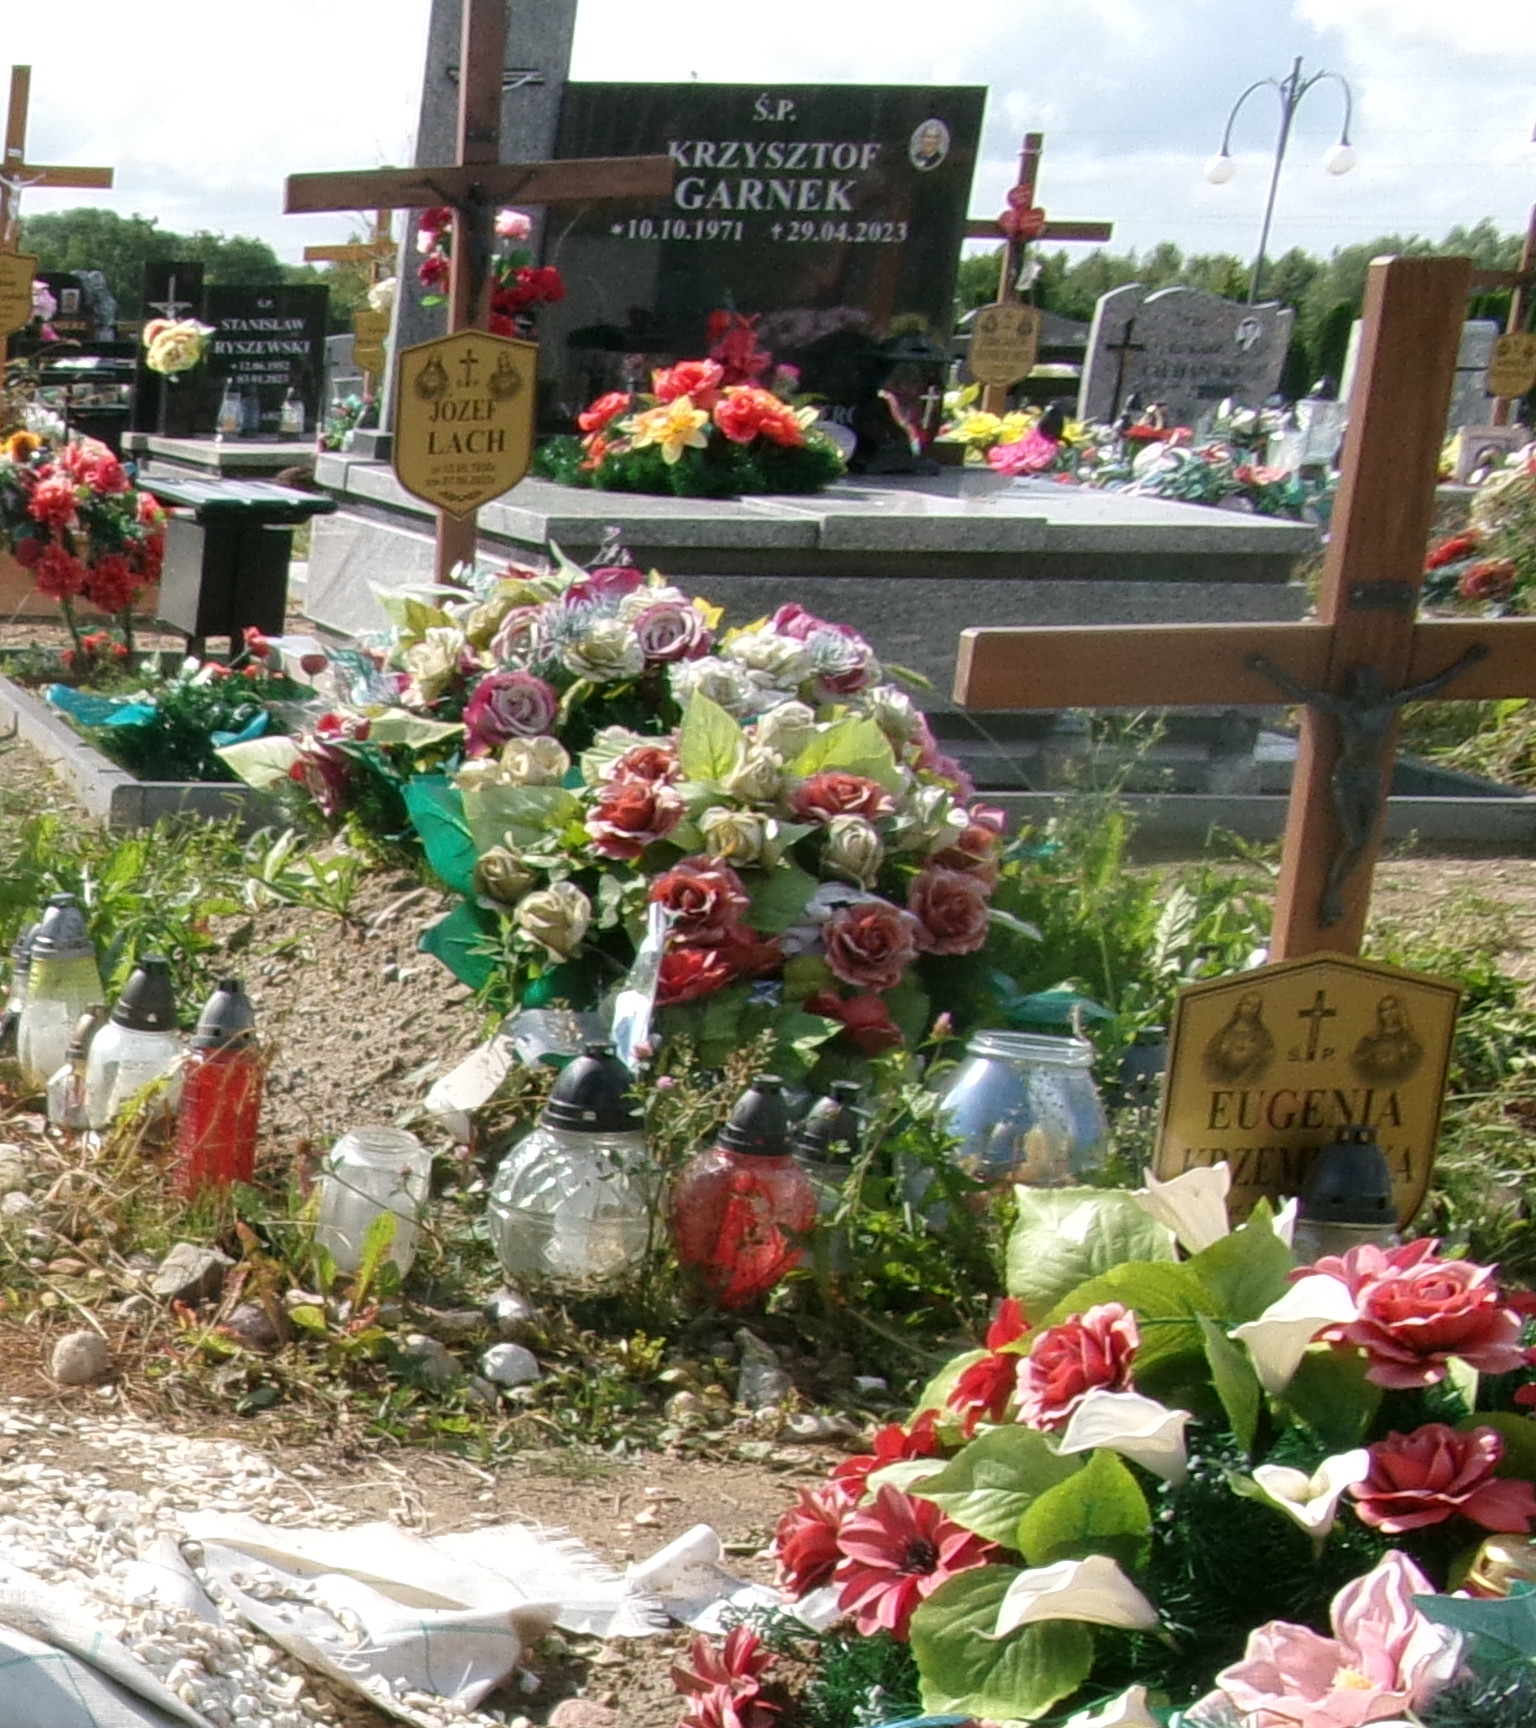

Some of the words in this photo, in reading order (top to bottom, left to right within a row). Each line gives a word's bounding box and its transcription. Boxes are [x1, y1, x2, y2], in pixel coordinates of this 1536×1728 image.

[753, 92, 797, 122] Ś.P.
[667, 141, 883, 171] KRZYSZTOF
[676, 177, 858, 212] GARNEK
[786, 221, 910, 243] 29.04.2023
[427, 429, 506, 455] LACH
[1206, 1088, 1404, 1130] EUGENIA
